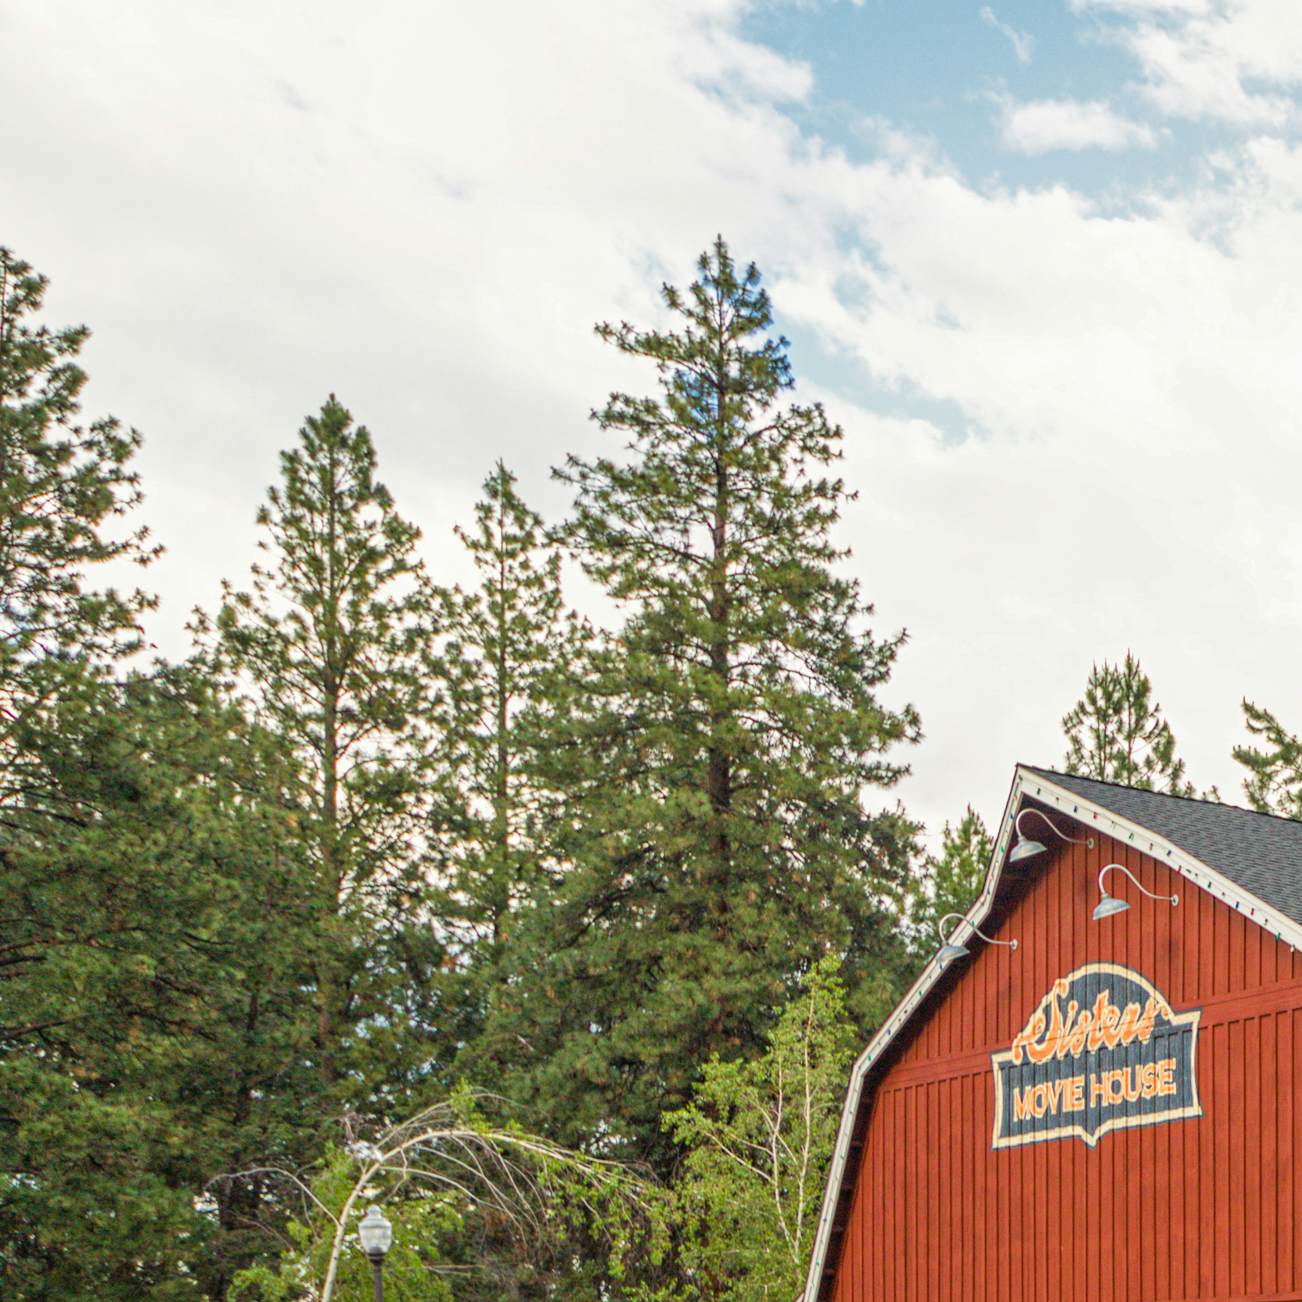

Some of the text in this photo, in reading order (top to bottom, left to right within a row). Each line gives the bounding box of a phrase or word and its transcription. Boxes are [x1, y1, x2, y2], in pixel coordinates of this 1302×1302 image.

[1012, 978, 1169, 1065] Sisters
[1013, 1057, 1177, 1122] MOVIE HOUSE
